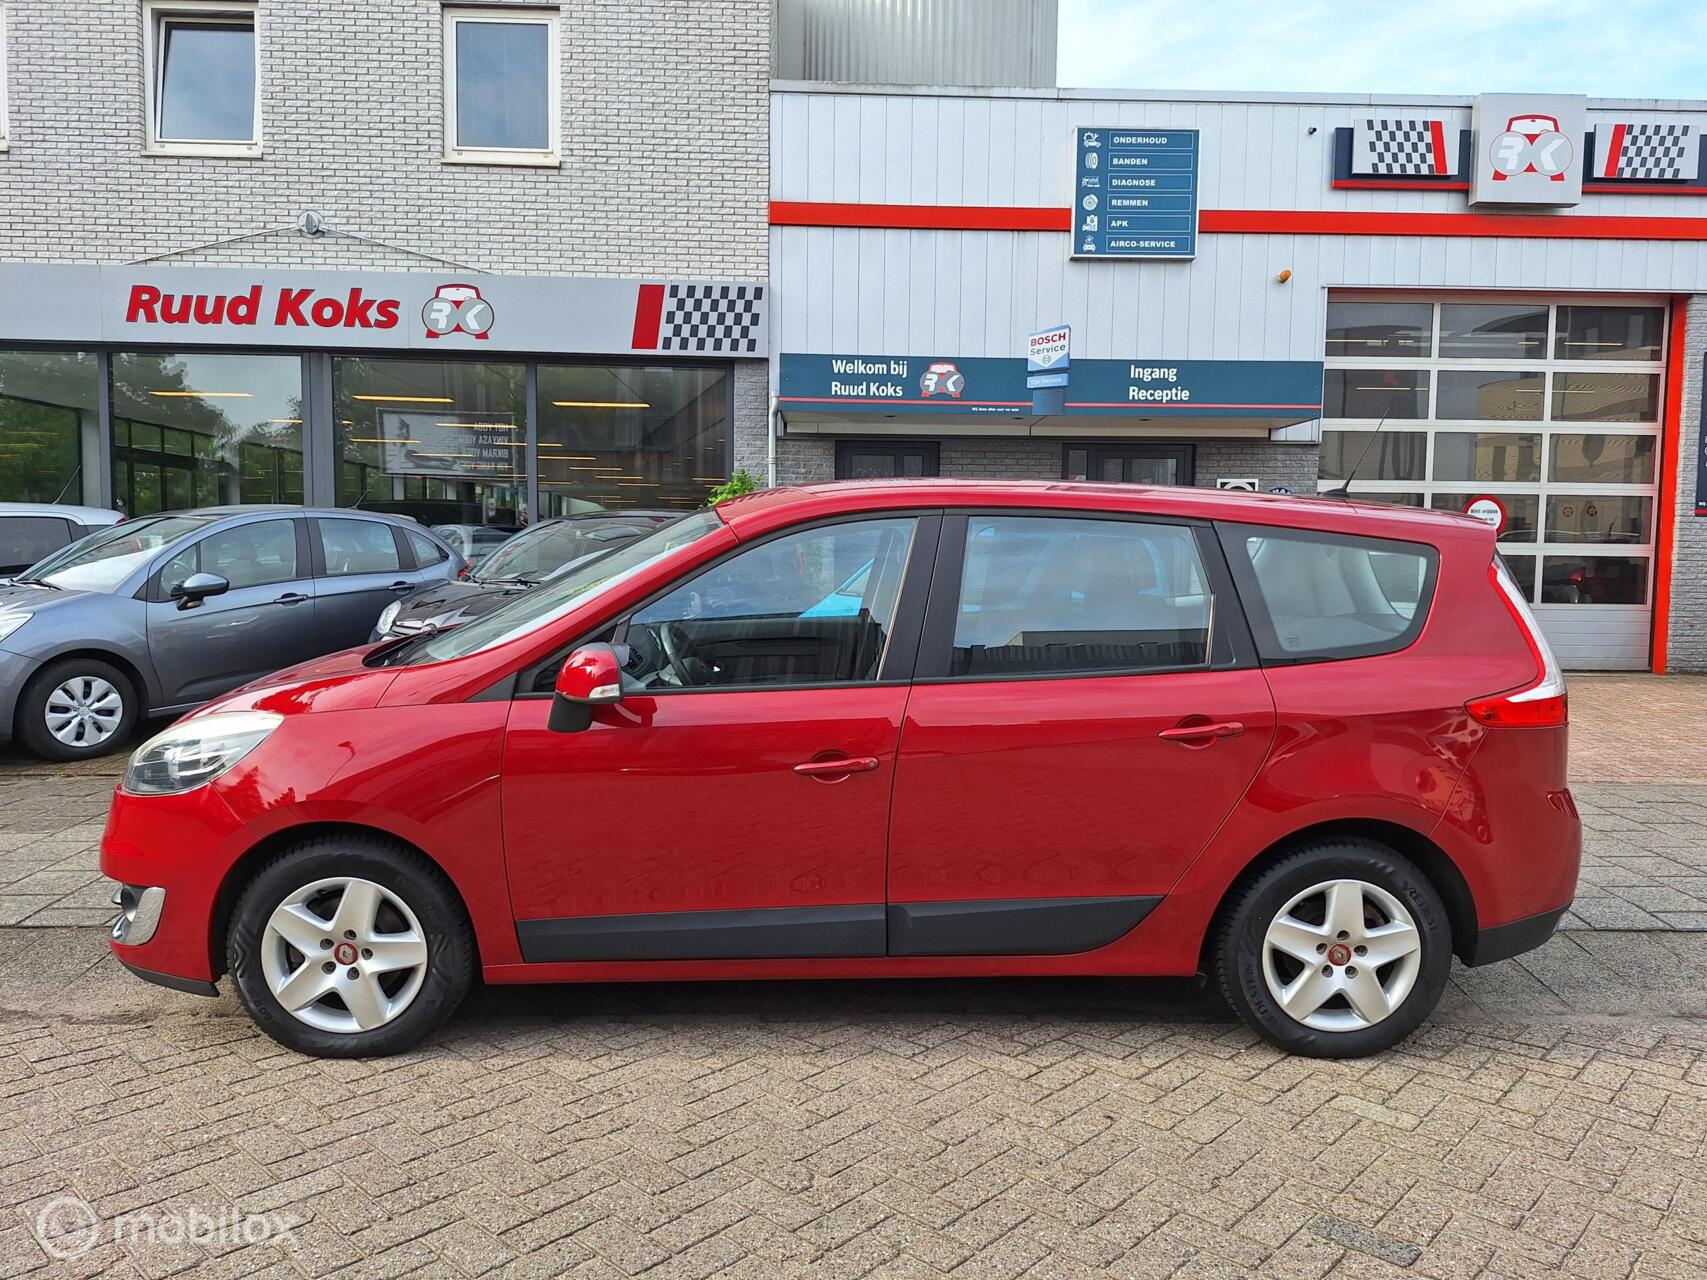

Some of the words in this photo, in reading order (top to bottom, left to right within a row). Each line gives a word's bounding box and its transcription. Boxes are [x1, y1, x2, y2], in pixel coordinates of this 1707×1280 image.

[1113, 136, 1168, 144] ONDERHOUD
[1110, 240, 1176, 248] AIRCO-SERVICE
[126, 284, 263, 325] Ruud
[274, 287, 400, 328] Koks
[1030, 332, 1066, 347] BOSCH
[1030, 344, 1066, 356] Service
[831, 359, 887, 375] Welkom
[890, 360, 908, 378] bij
[1130, 364, 1178, 382] Ingang
[831, 381, 867, 396] Ruud
[869, 382, 903, 397] Koks
[1128, 386, 1190, 404] Receptie
